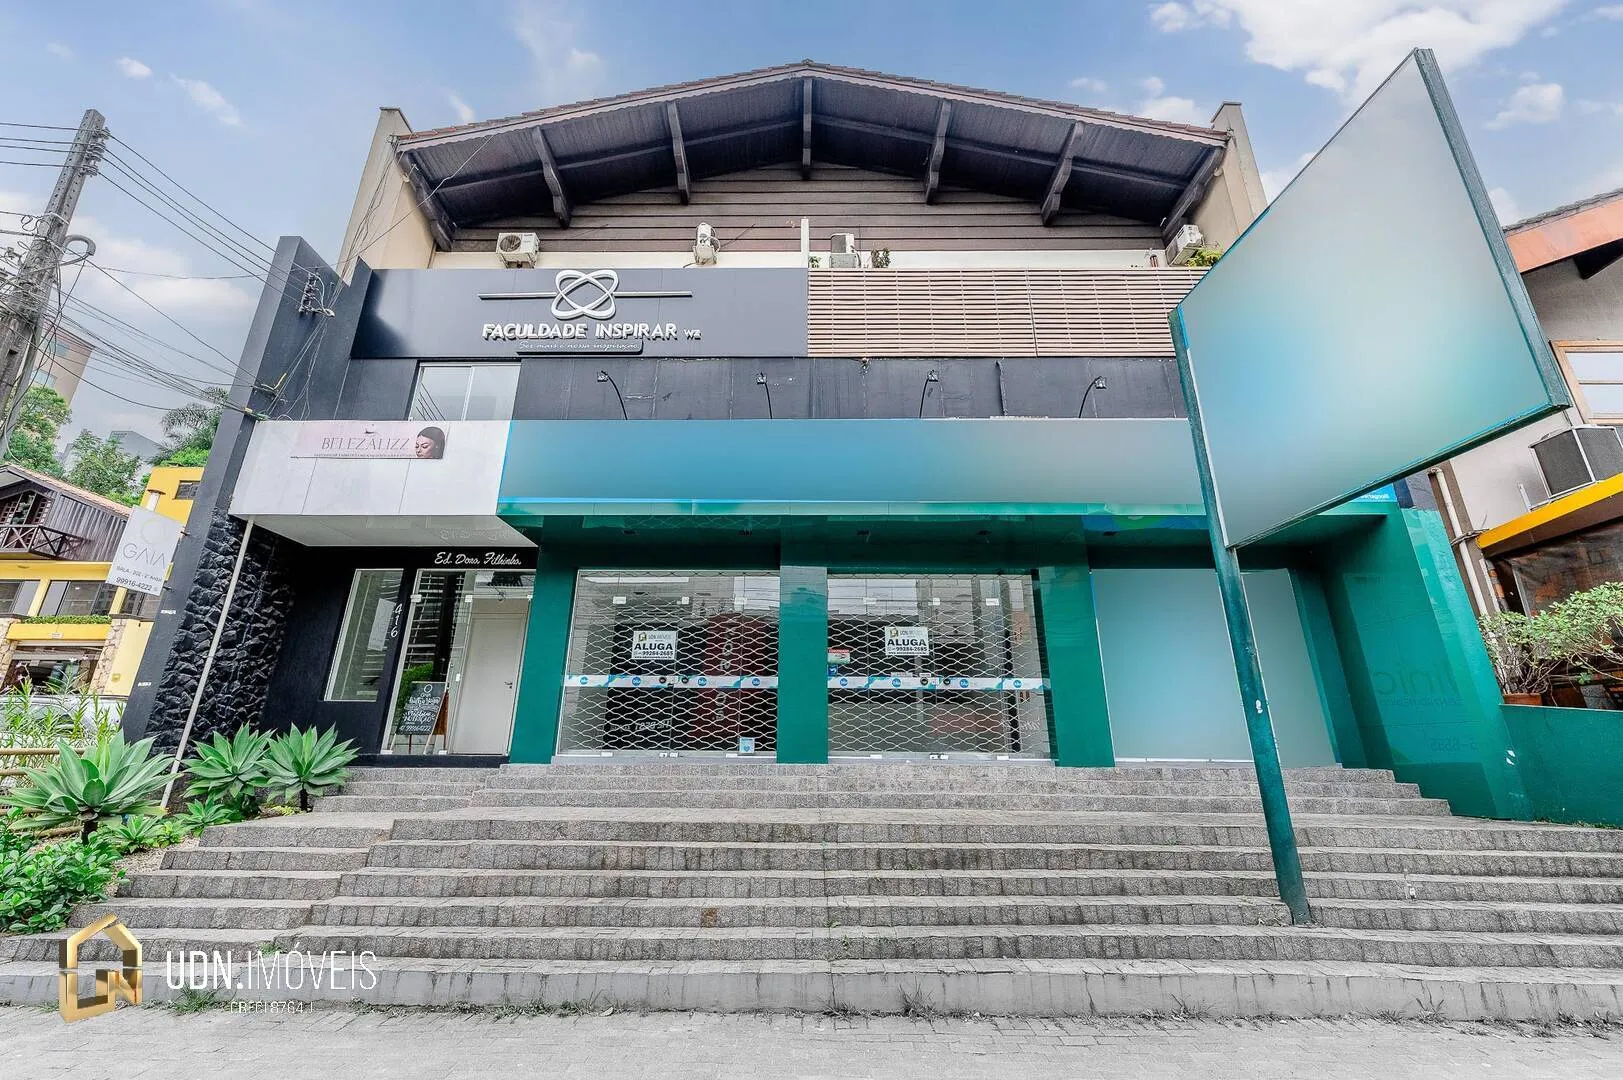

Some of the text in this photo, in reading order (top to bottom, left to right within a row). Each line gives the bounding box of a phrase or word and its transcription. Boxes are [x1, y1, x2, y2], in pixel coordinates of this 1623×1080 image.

[481, 322, 588, 340] FACULDADE
[594, 322, 678, 340] INSPIRAR
[390, 603, 403, 638] 416
[634, 642, 674, 651] ALUGA
[888, 638, 927, 647] ALUGA
